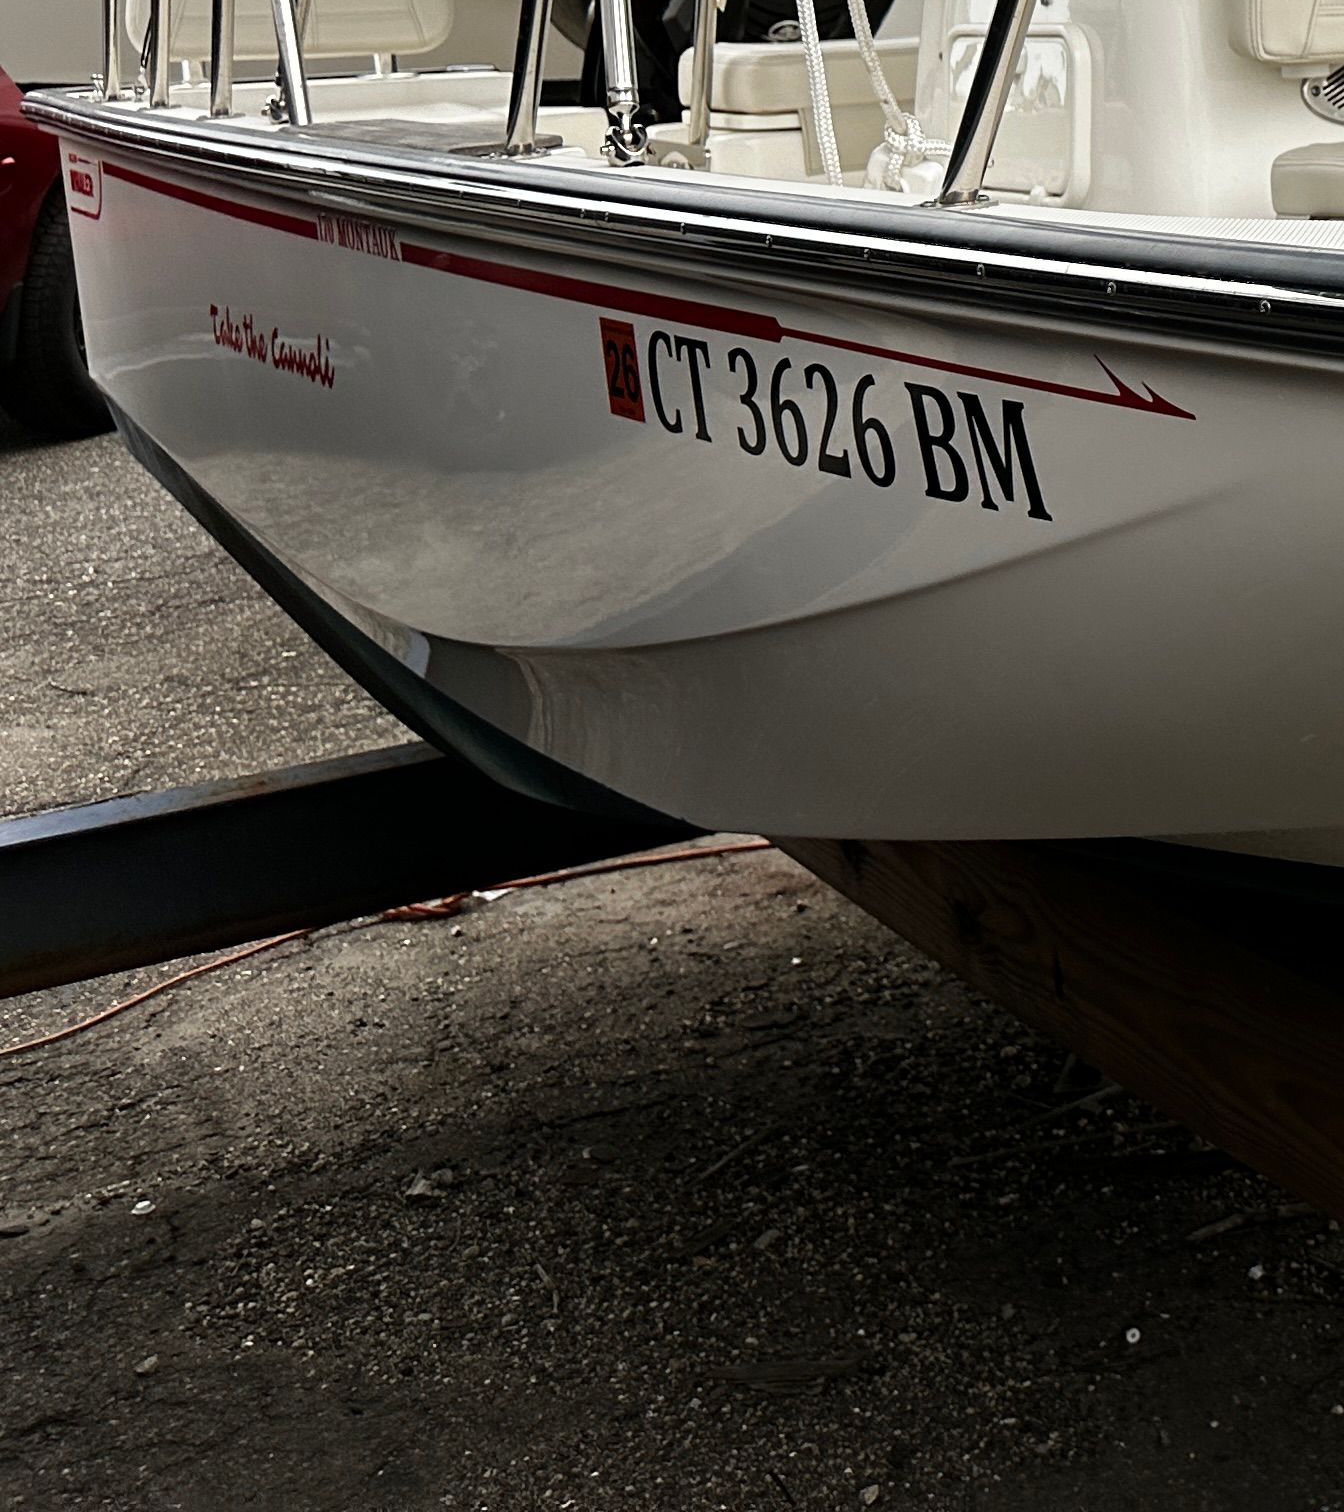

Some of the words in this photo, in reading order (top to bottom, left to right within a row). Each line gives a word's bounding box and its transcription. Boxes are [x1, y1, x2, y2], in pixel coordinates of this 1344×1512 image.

[336, 217, 401, 262] MONTAUK
[209, 303, 243, 353] Take
[242, 314, 269, 363] the
[271, 326, 335, 390] Cannoli
[606, 340, 640, 403] 26
[648, 330, 713, 443] CT
[727, 347, 896, 487] 3626
[903, 381, 1053, 522] BM
